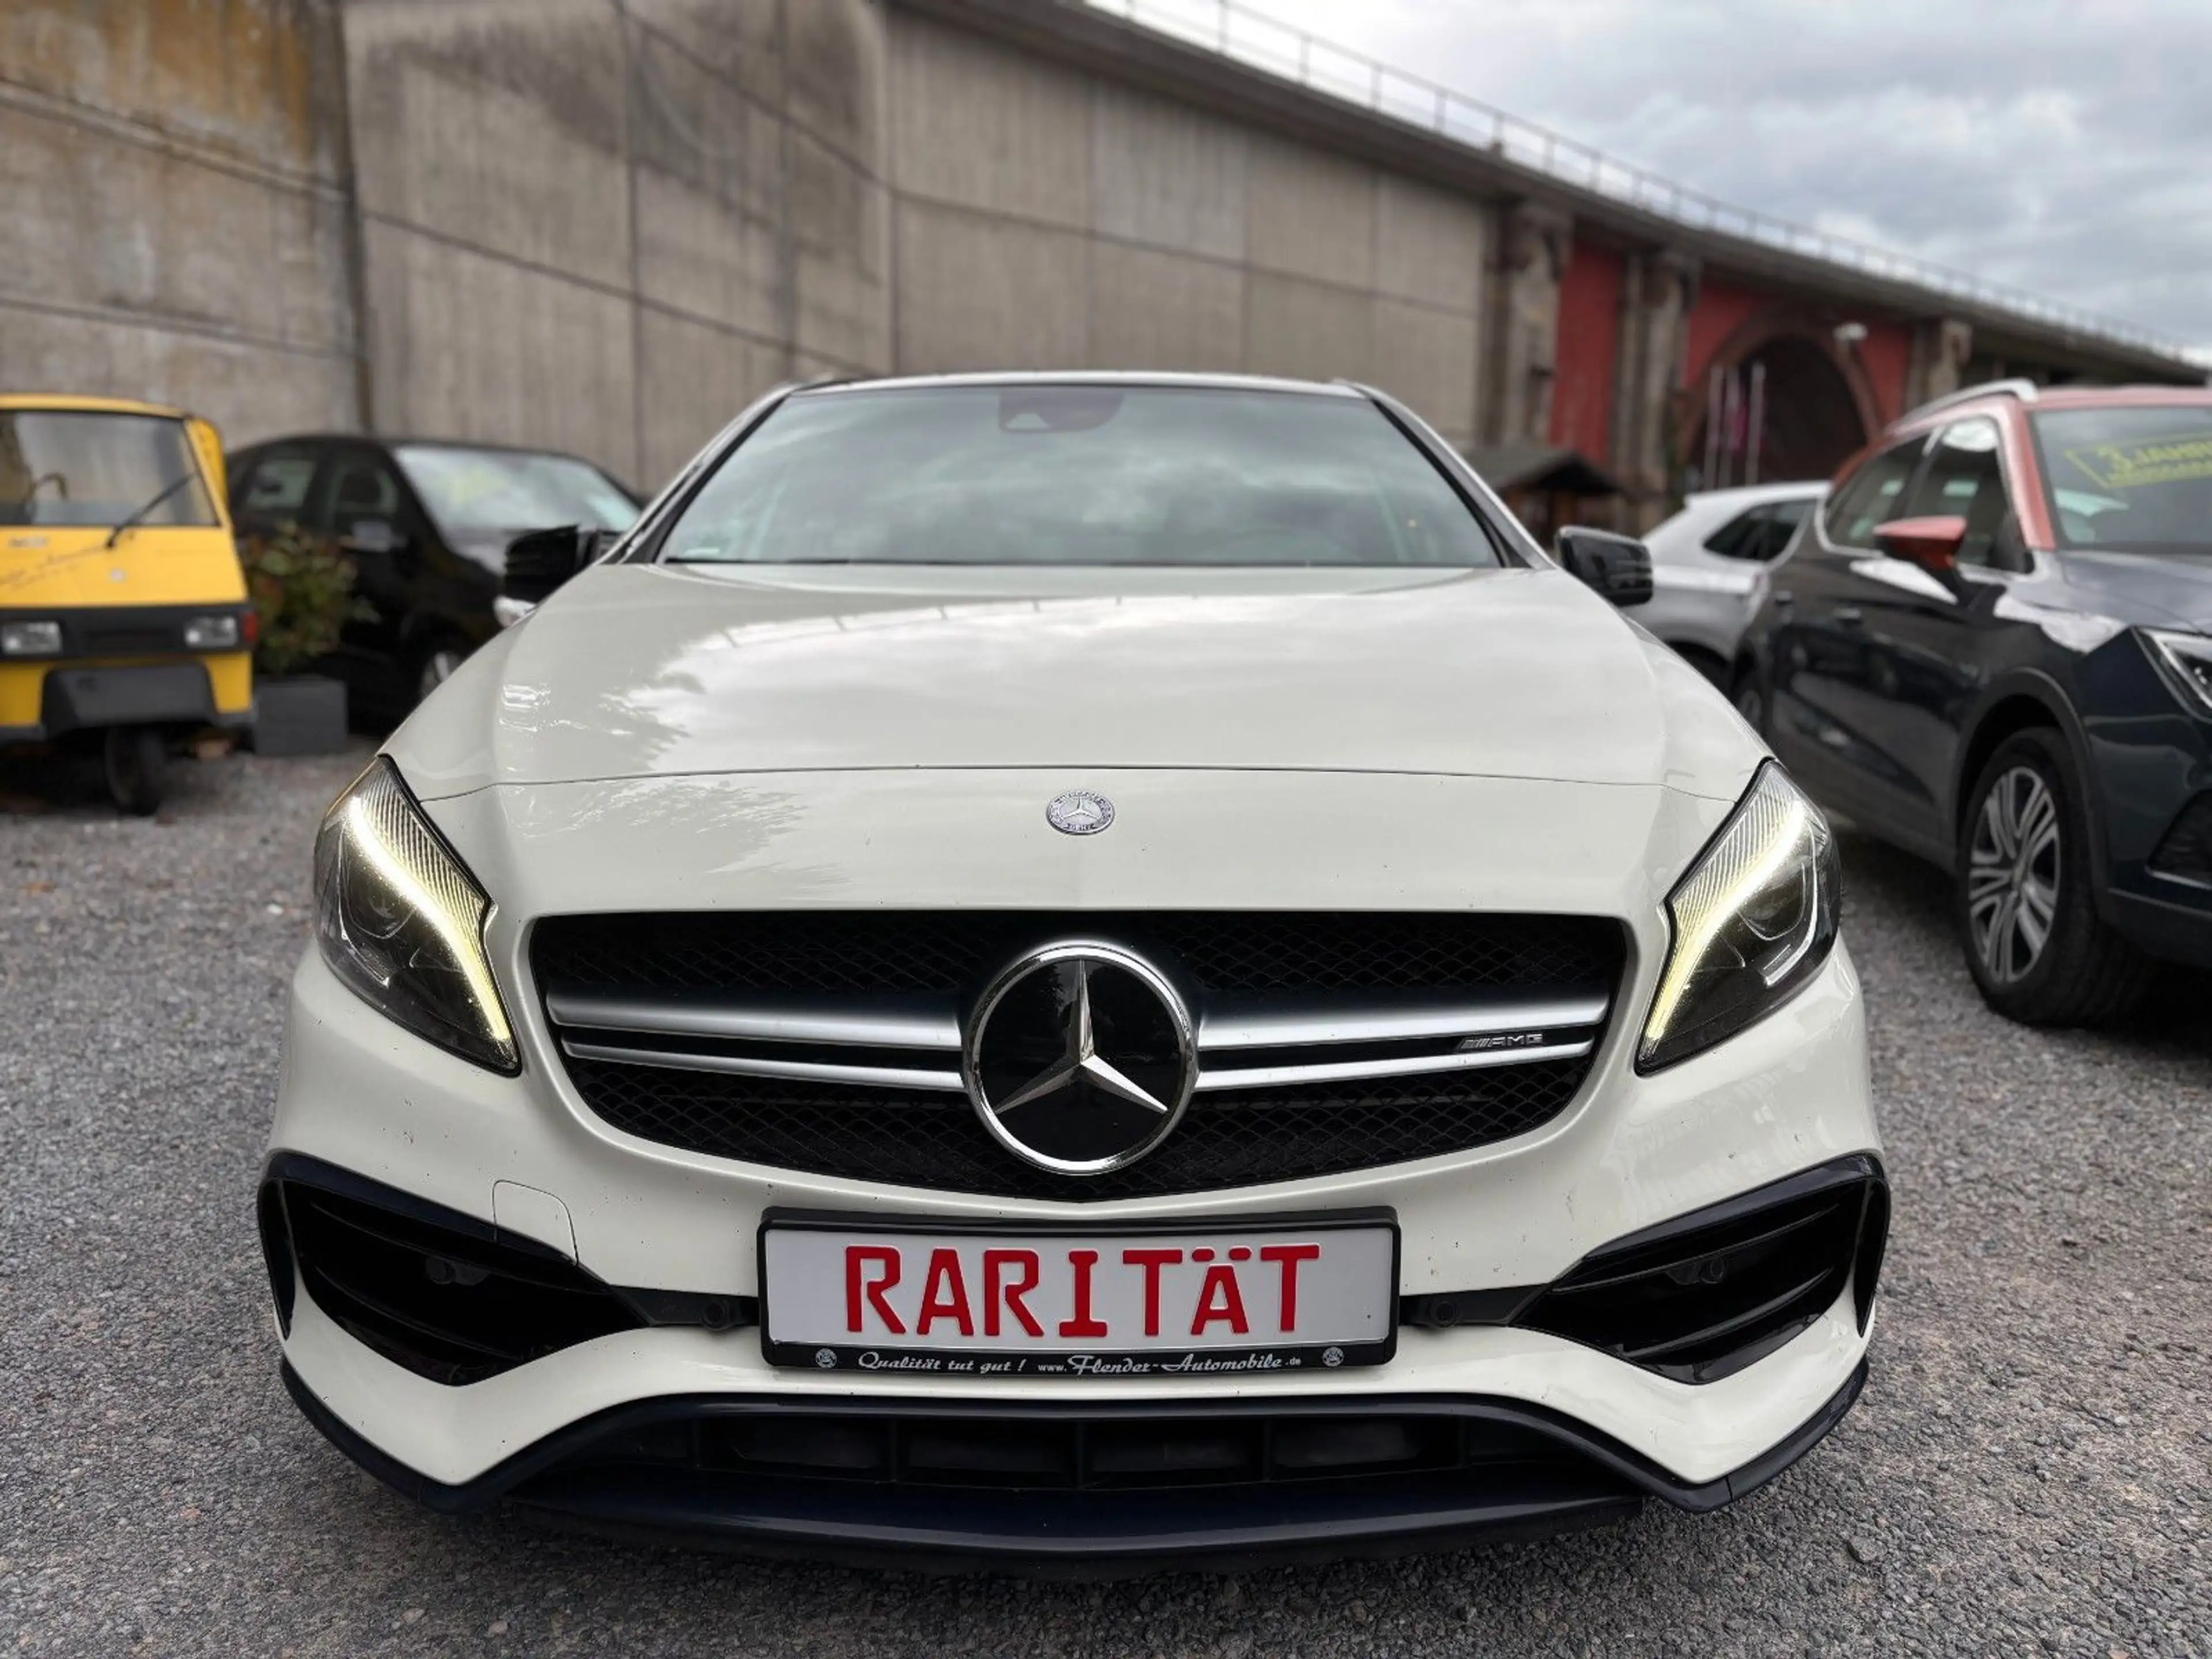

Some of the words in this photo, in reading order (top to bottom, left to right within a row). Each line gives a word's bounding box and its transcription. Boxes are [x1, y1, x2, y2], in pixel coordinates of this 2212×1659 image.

[1491, 1033, 1543, 1047] AMG
[846, 1245, 1319, 1336] RARITÄT
[858, 1351, 941, 1370] Qualität
[948, 1359, 974, 1371] tut
[980, 1361, 1012, 1374] gut
